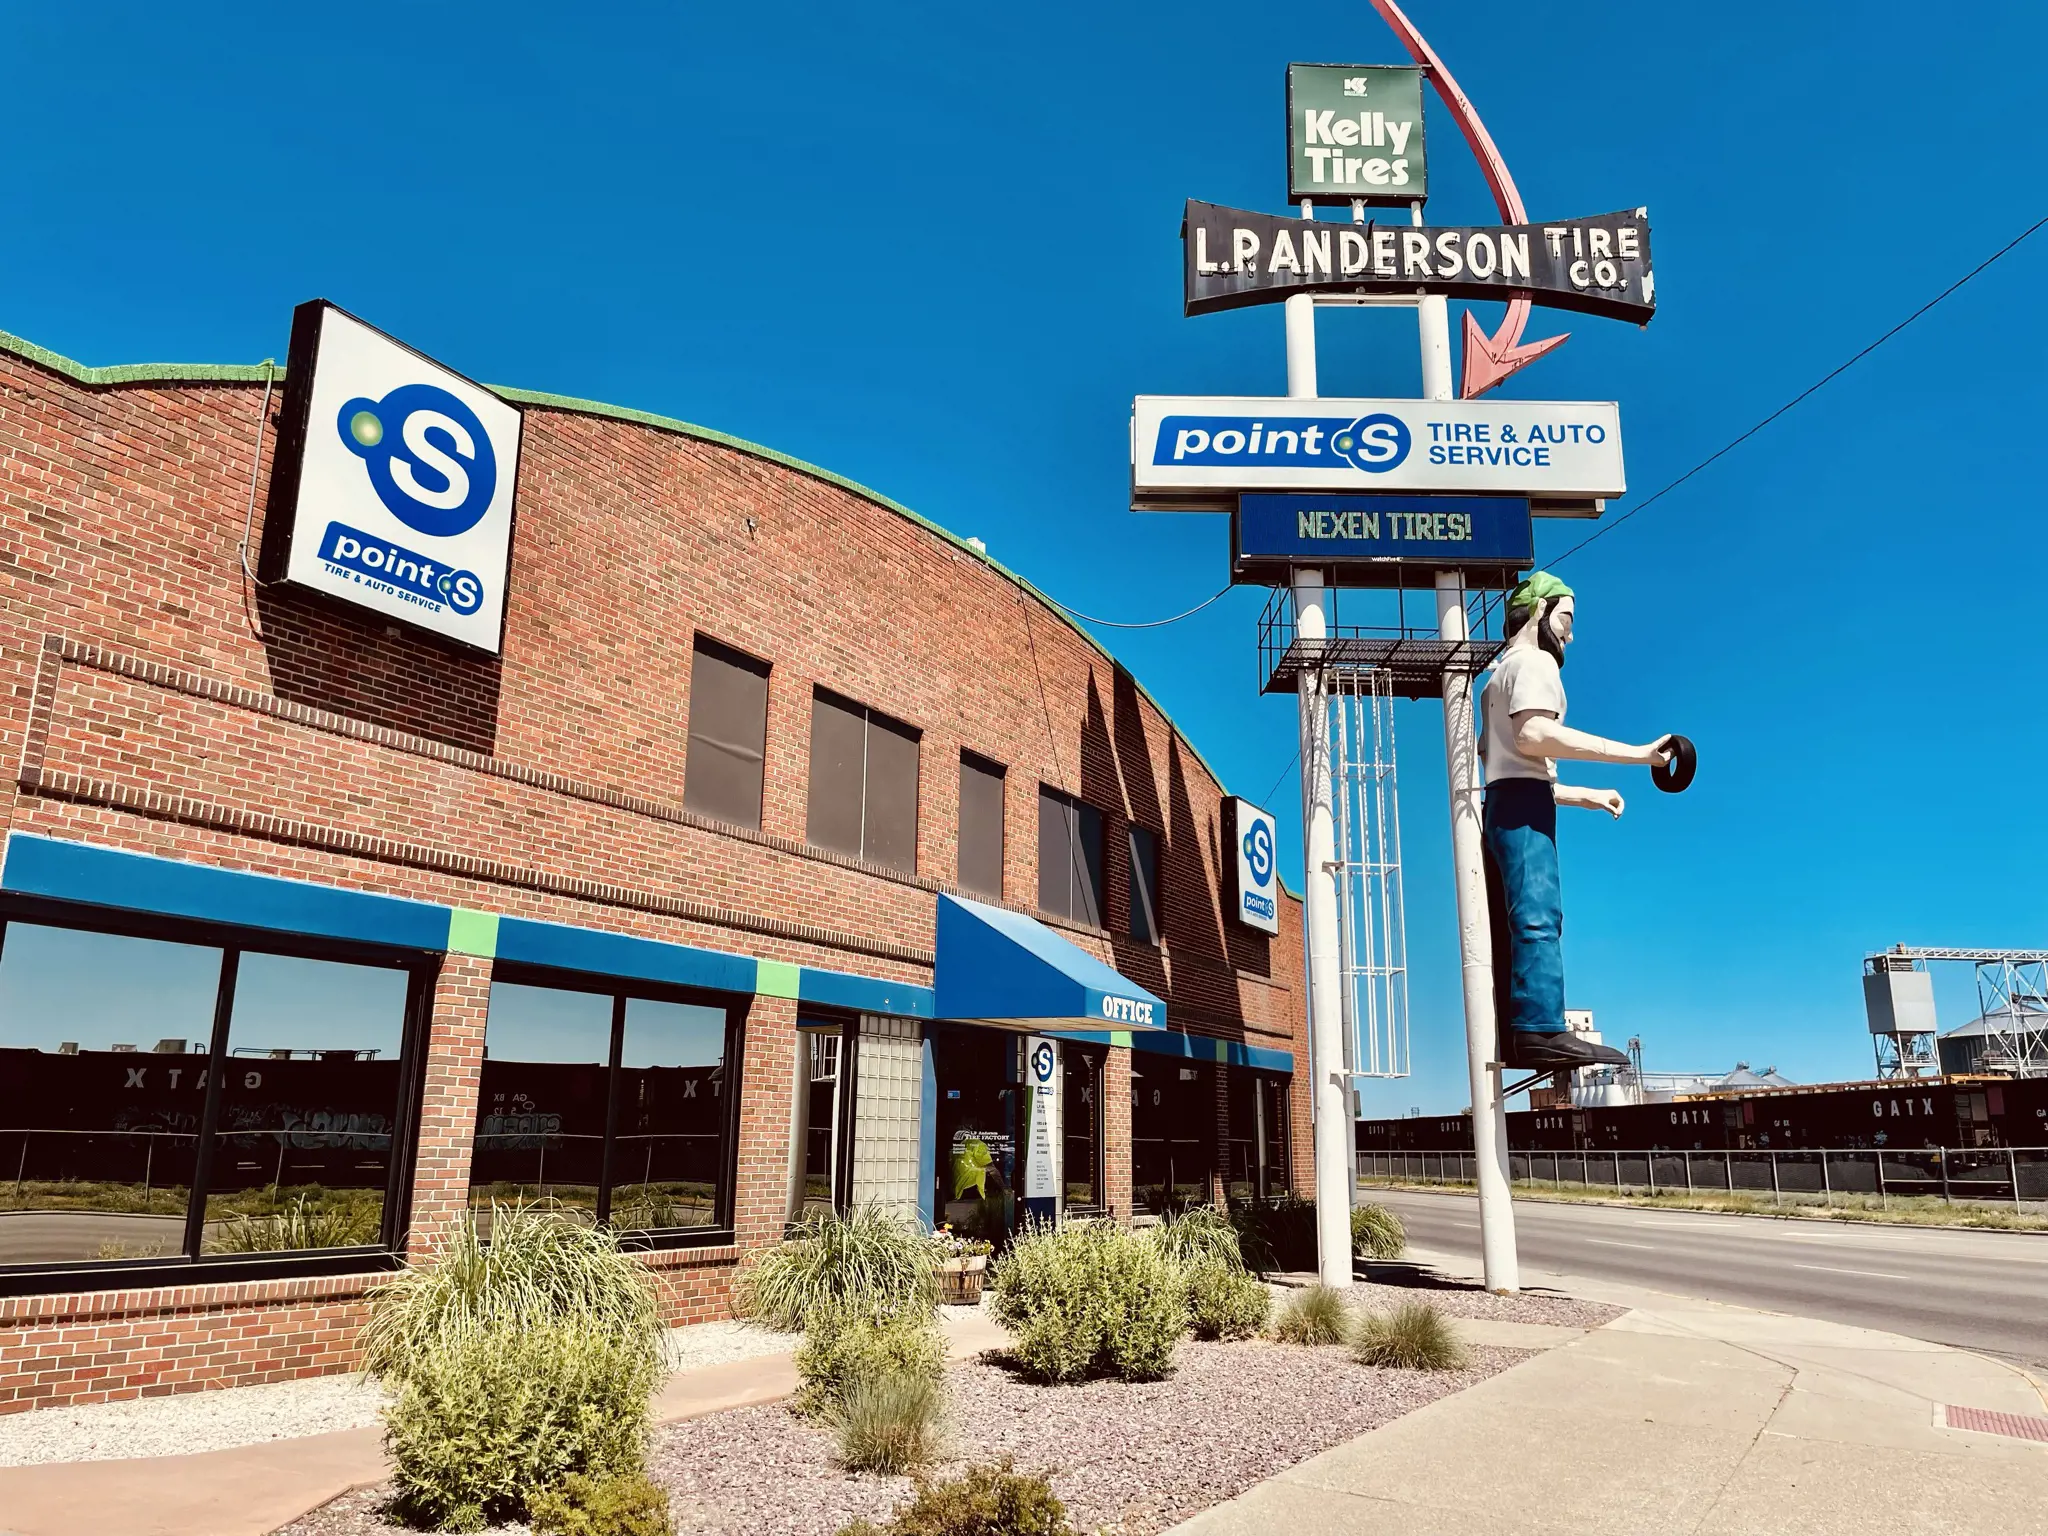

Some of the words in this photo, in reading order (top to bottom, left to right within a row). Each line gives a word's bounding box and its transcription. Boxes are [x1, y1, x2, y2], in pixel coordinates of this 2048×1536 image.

[1304, 109, 1412, 155] Kelly
[1304, 148, 1409, 185] Tires
[1268, 229, 1530, 278] ANDERSON
[1543, 227, 1639, 258] TIRE
[1569, 260, 1628, 288] CO.
[1172, 422, 1323, 459] point
[1355, 423, 1400, 461] S
[1427, 423, 1497, 443] TIRE
[1500, 424, 1519, 443] &
[1527, 424, 1607, 444] AUTO
[389, 409, 476, 510] S
[1429, 446, 1551, 466] SERVICE
[1297, 511, 1380, 540] NEXEN
[1386, 511, 1472, 541] TIRES!
[333, 535, 435, 588] point
[452, 577, 478, 608] S
[324, 563, 351, 579] TIRE
[354, 574, 361, 583] &
[365, 579, 394, 595] AUTO
[397, 590, 442, 613] SERVICE
[1253, 829, 1269, 875] S
[1246, 895, 1265, 911] point
[1102, 995, 1153, 1025] OFFICE
[1037, 1048, 1051, 1076] S
[1670, 1110, 1710, 1125] GATX
[1873, 1098, 1934, 1117] GATX
[1536, 1117, 1563, 1129] GATX
